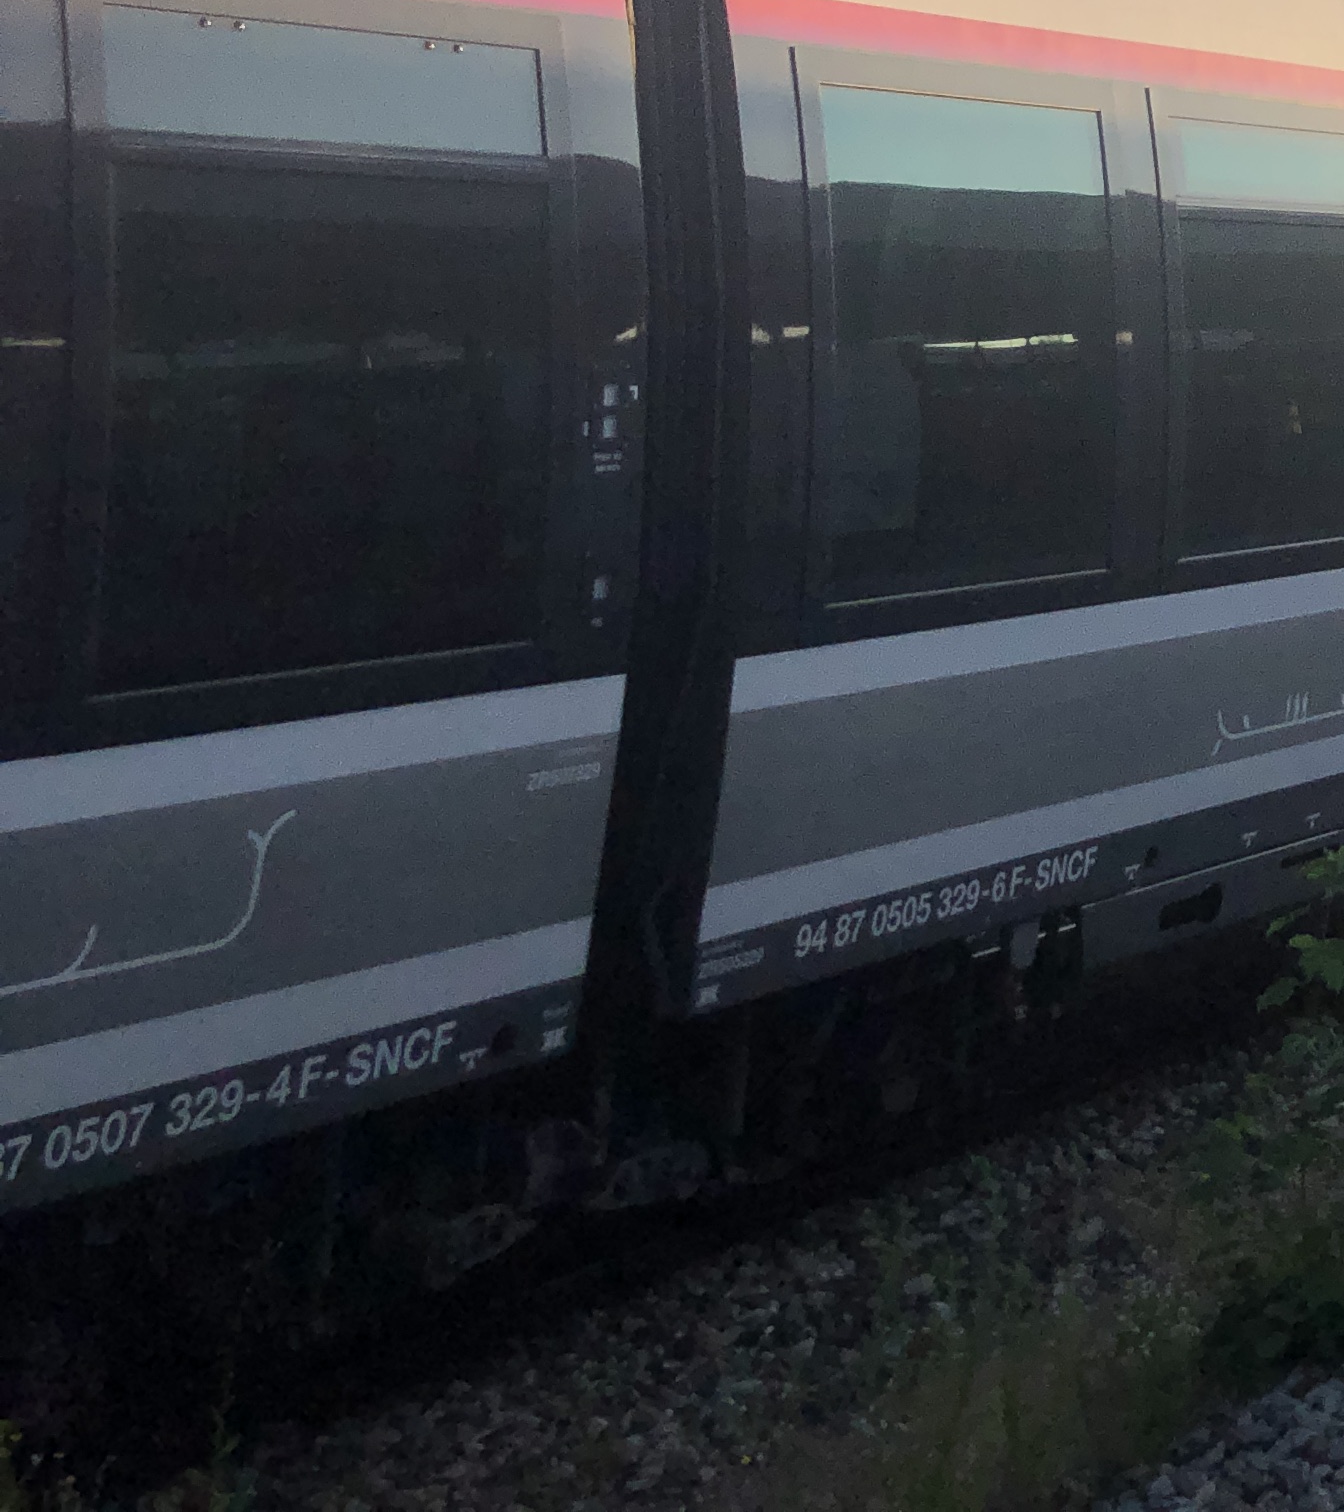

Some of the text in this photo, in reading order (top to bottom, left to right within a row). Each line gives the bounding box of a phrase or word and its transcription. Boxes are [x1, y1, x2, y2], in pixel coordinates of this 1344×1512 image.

[794, 918, 828, 958] 94
[832, 910, 867, 948] 87
[871, 891, 933, 936] 0505
[0, 1133, 33, 1181] 7
[44, 1101, 156, 1170] 0507
